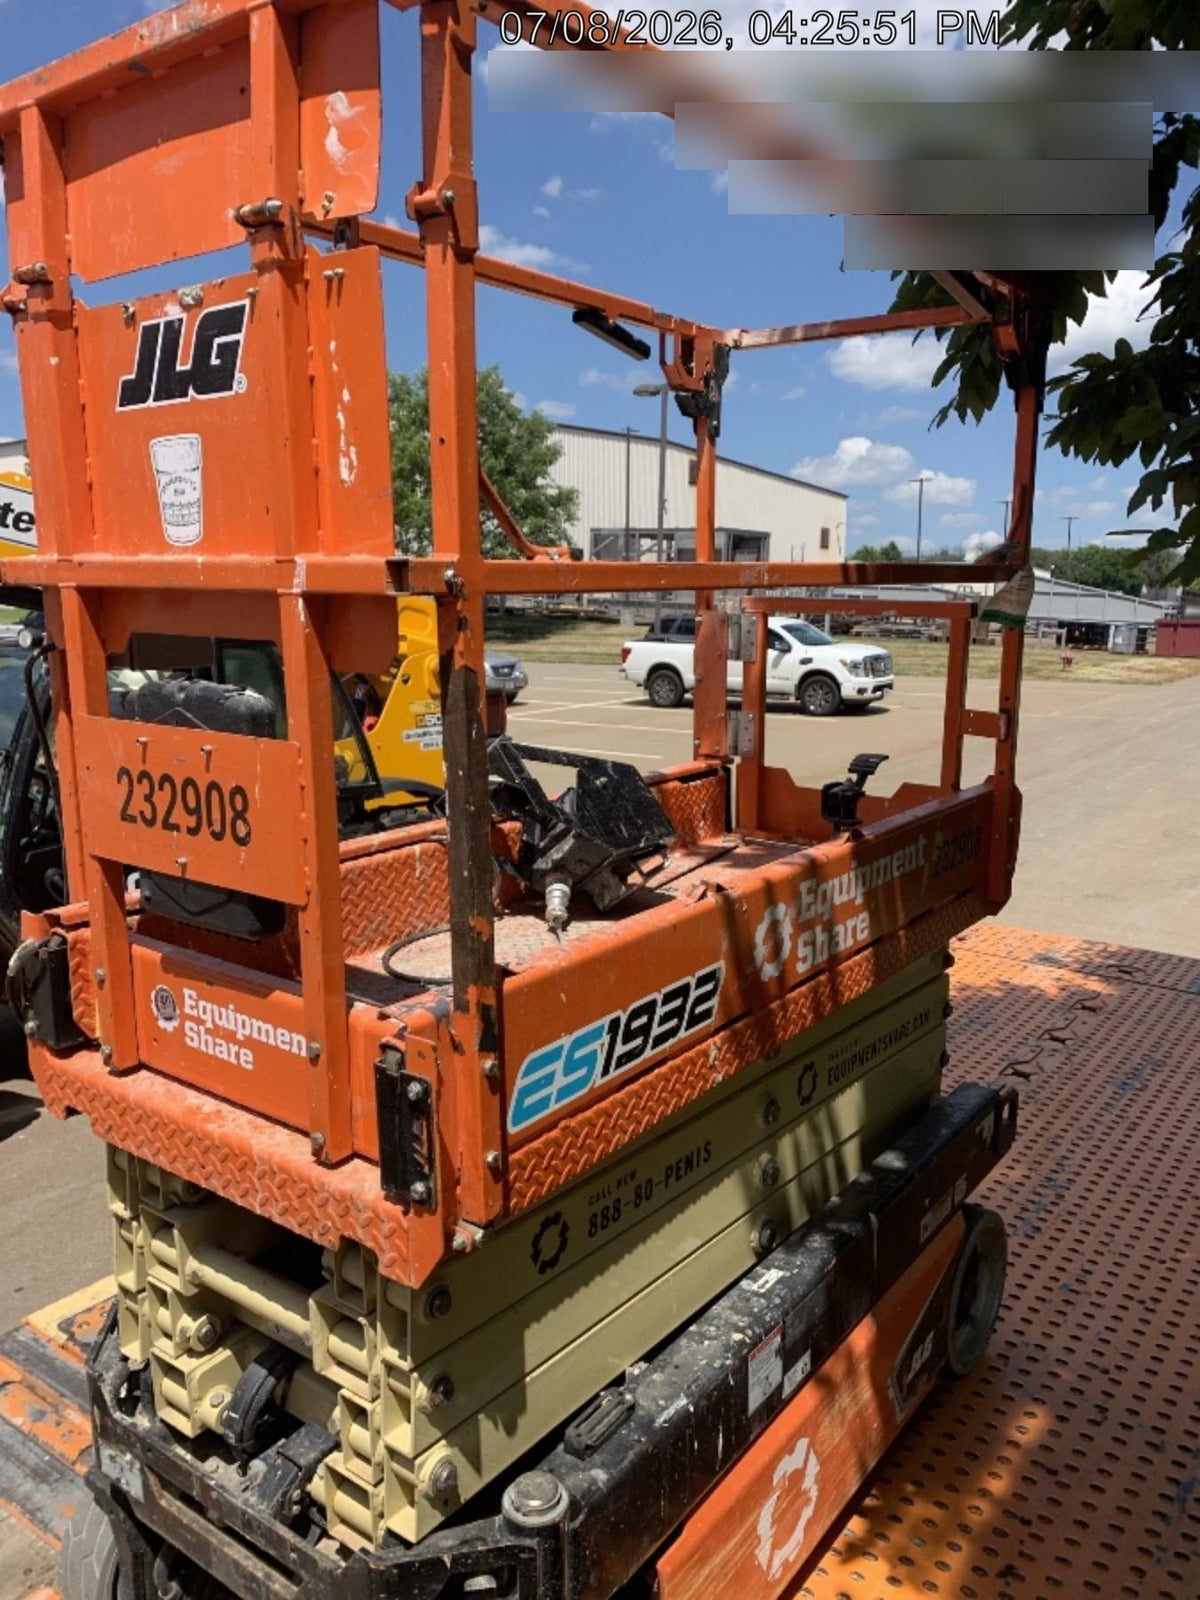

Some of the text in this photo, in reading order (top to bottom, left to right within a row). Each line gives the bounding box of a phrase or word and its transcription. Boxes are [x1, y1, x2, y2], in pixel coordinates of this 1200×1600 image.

[116, 299, 250, 412] JLG
[116, 766, 251, 847] 232908
[797, 832, 927, 923] Equipment
[796, 911, 870, 974] Share
[184, 1020, 254, 1070] Share
[507, 960, 726, 1134] ES1932
